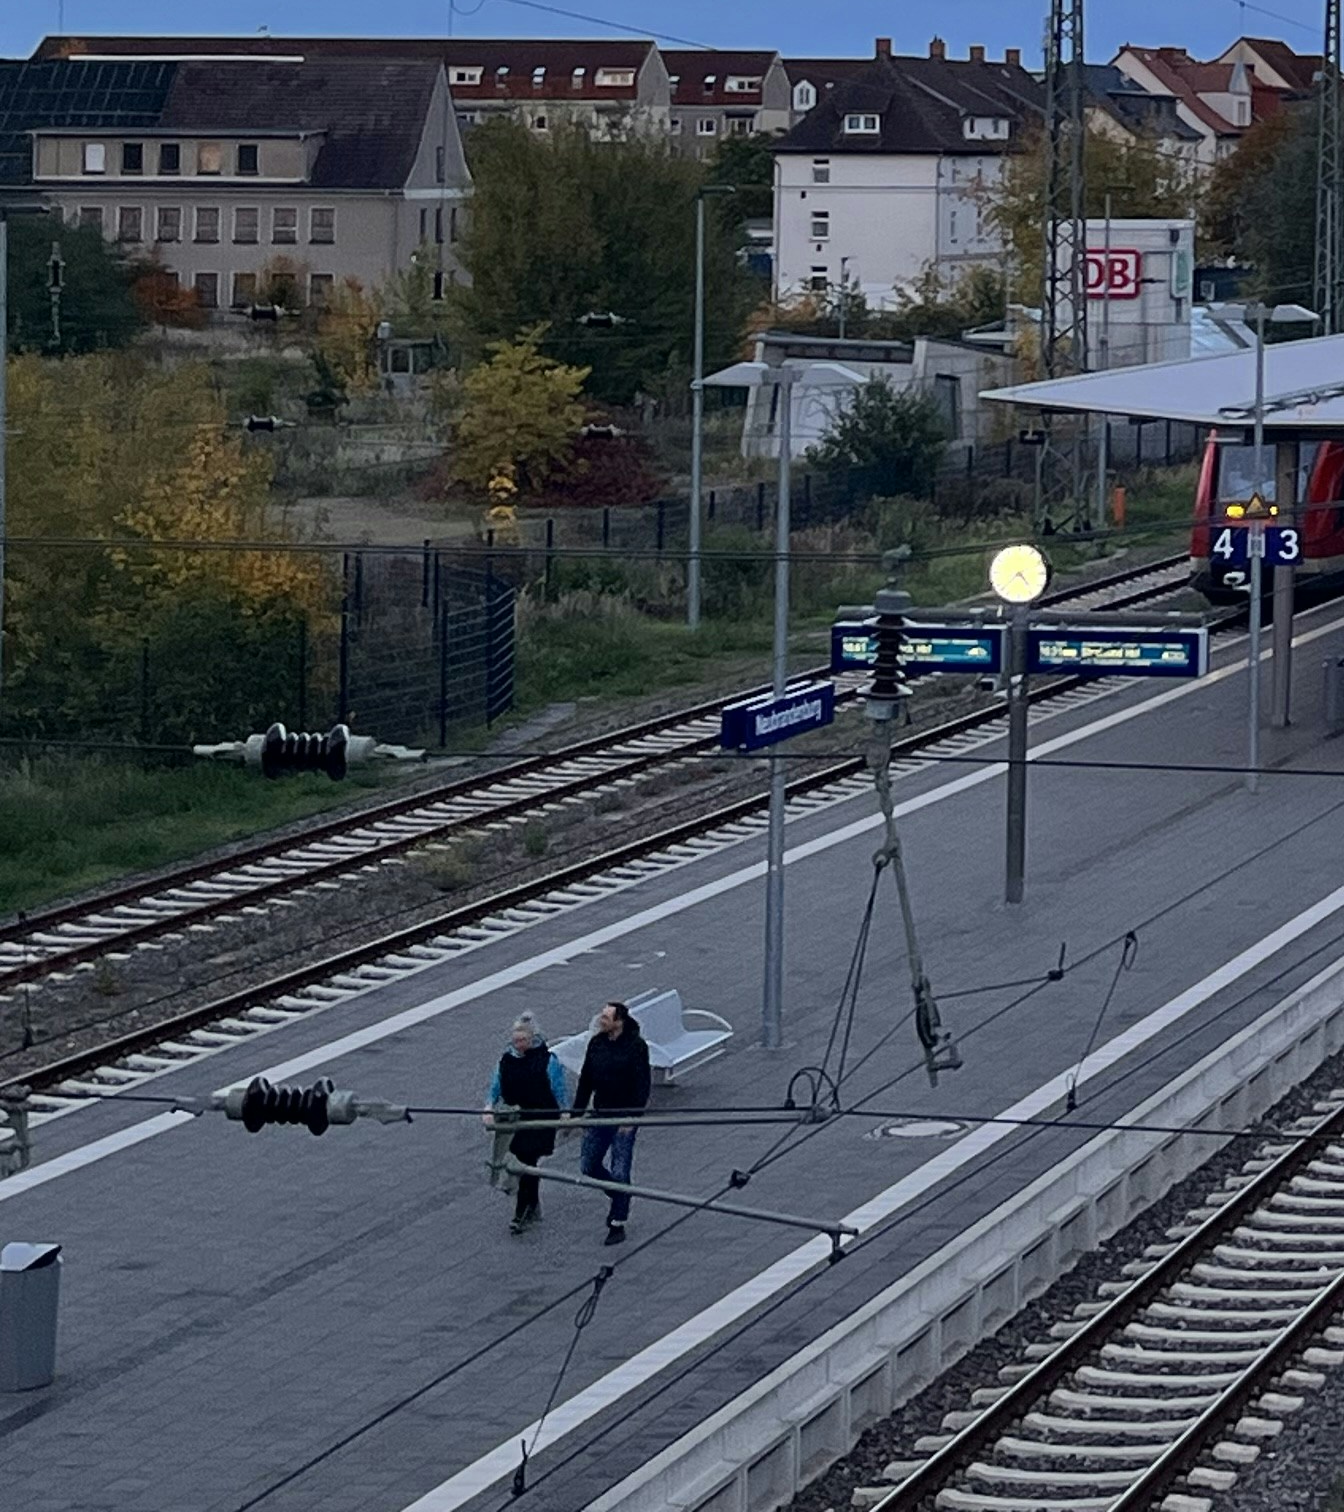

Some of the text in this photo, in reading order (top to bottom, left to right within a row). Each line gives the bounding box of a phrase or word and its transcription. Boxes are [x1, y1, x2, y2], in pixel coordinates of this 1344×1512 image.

[1084, 258, 1132, 288] DB
[1213, 528, 1234, 560] 4
[1279, 529, 1299, 560] 3
